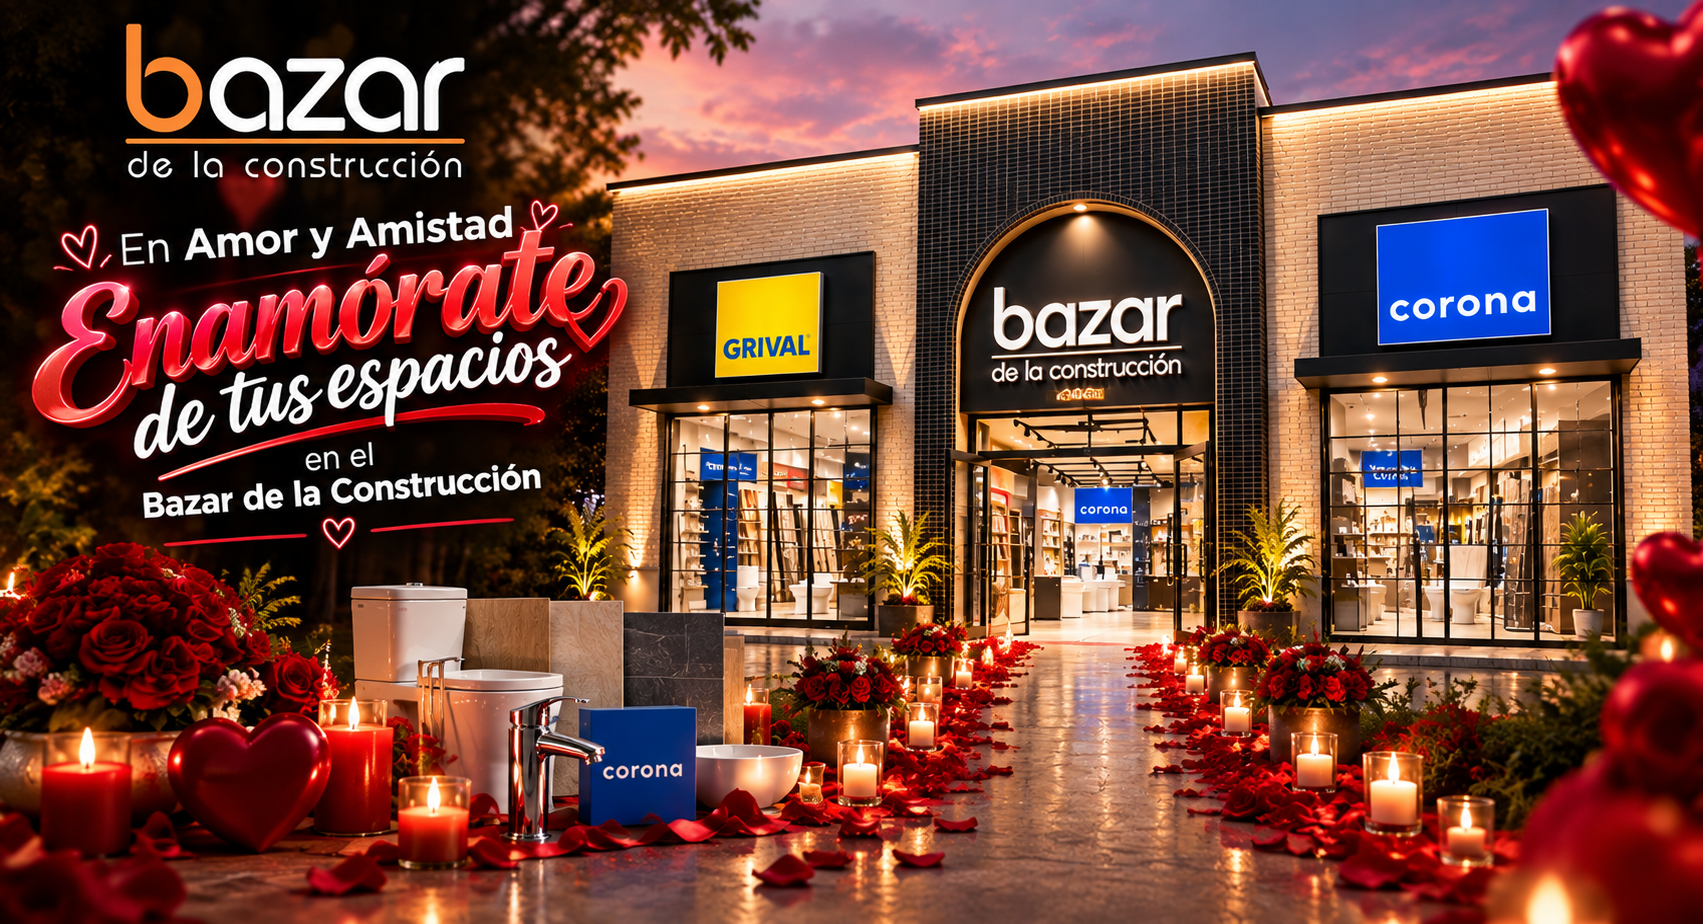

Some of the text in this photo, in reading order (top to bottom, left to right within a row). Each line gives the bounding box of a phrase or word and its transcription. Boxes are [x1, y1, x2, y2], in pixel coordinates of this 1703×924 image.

[993, 286, 1183, 351] bazar
[1389, 290, 1536, 322] corona
[723, 334, 811, 360] GRIVAL
[991, 352, 1182, 383] de la construcción
[1080, 505, 1128, 515] corona
[602, 763, 683, 780] corona
